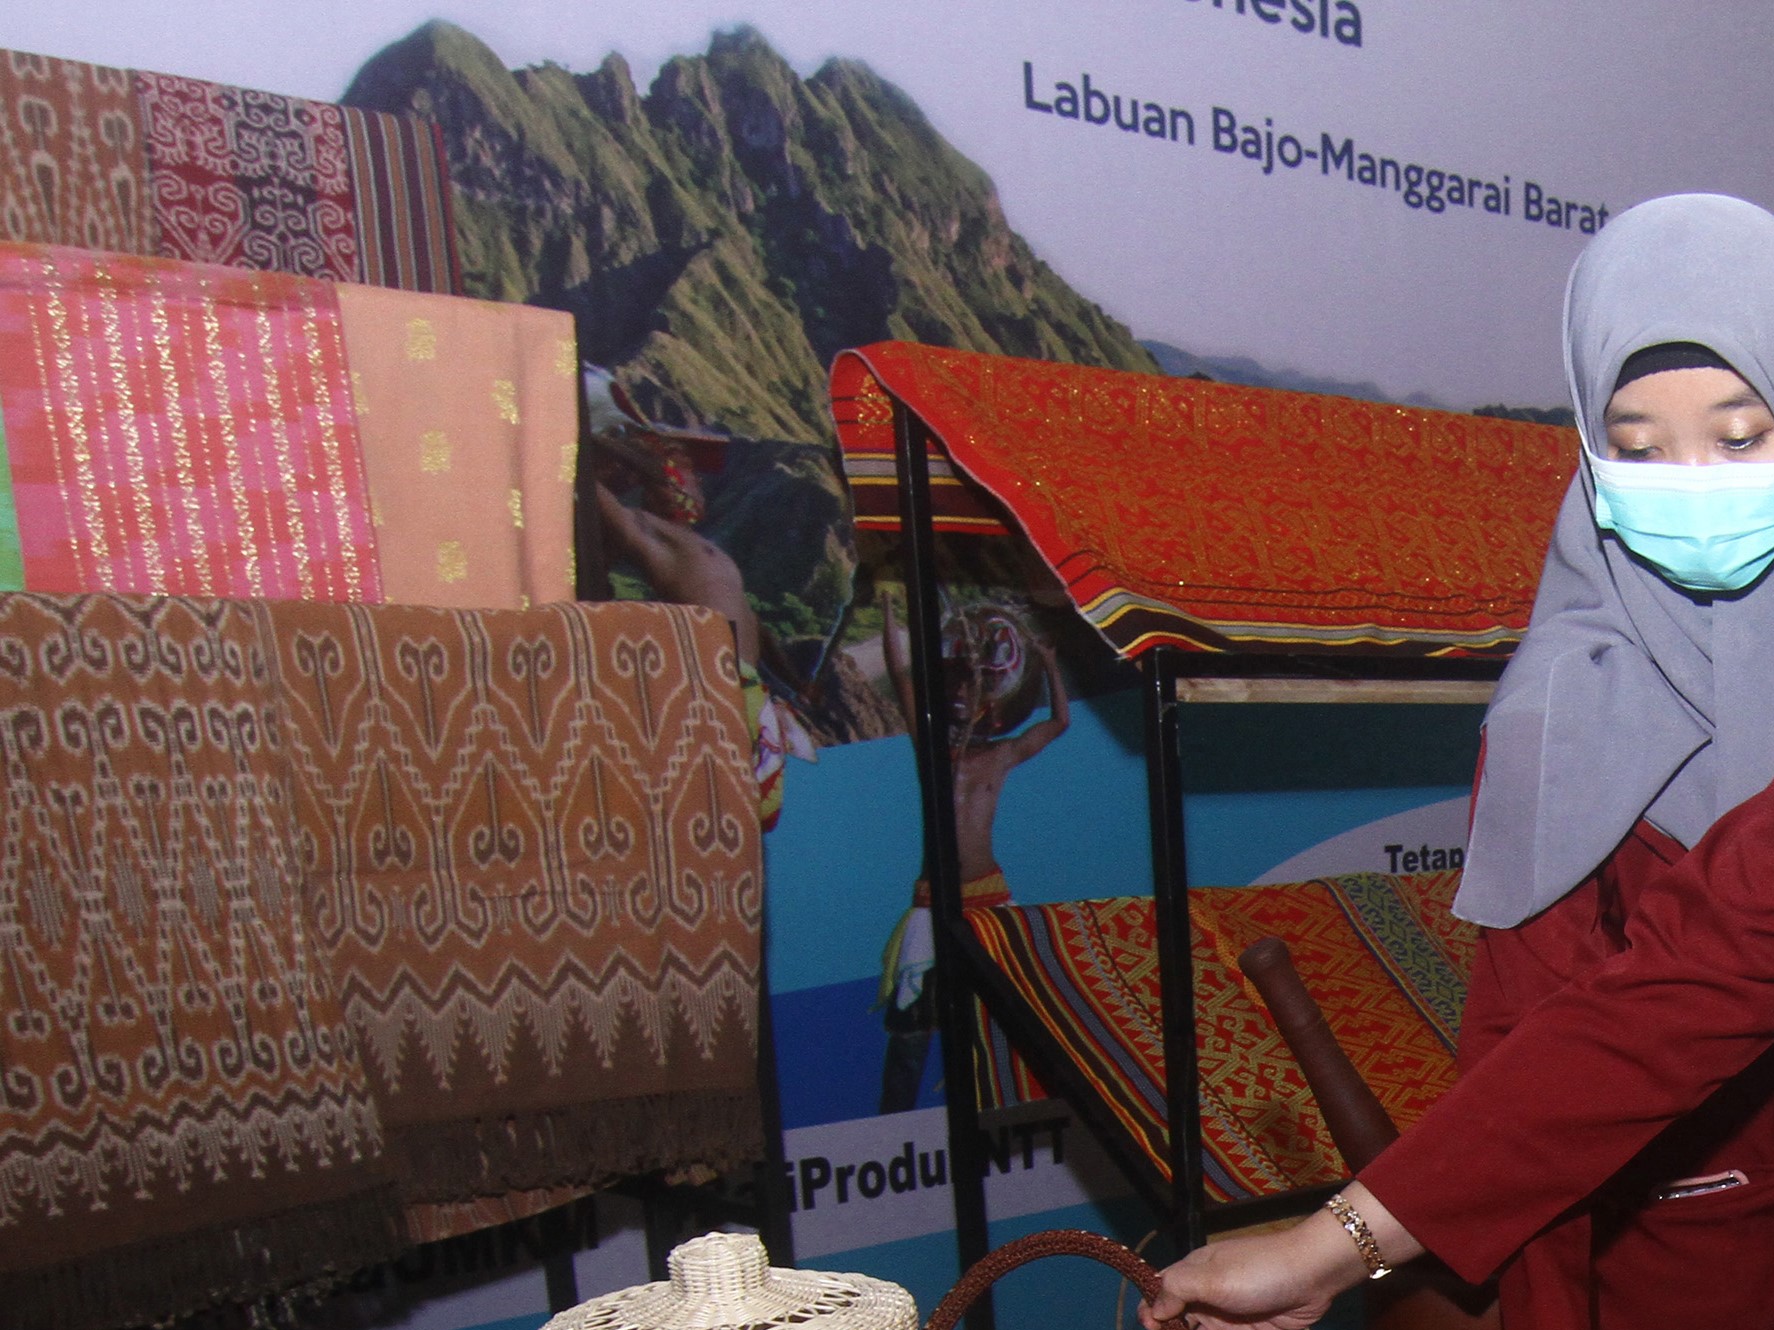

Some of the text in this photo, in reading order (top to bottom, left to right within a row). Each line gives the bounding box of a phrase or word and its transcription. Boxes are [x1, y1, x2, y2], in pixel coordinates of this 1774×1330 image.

[1023, 61, 1195, 146] Labuan
[1212, 106, 1511, 216] Bajo-Manggarai
[1524, 181, 1610, 235] Barat
